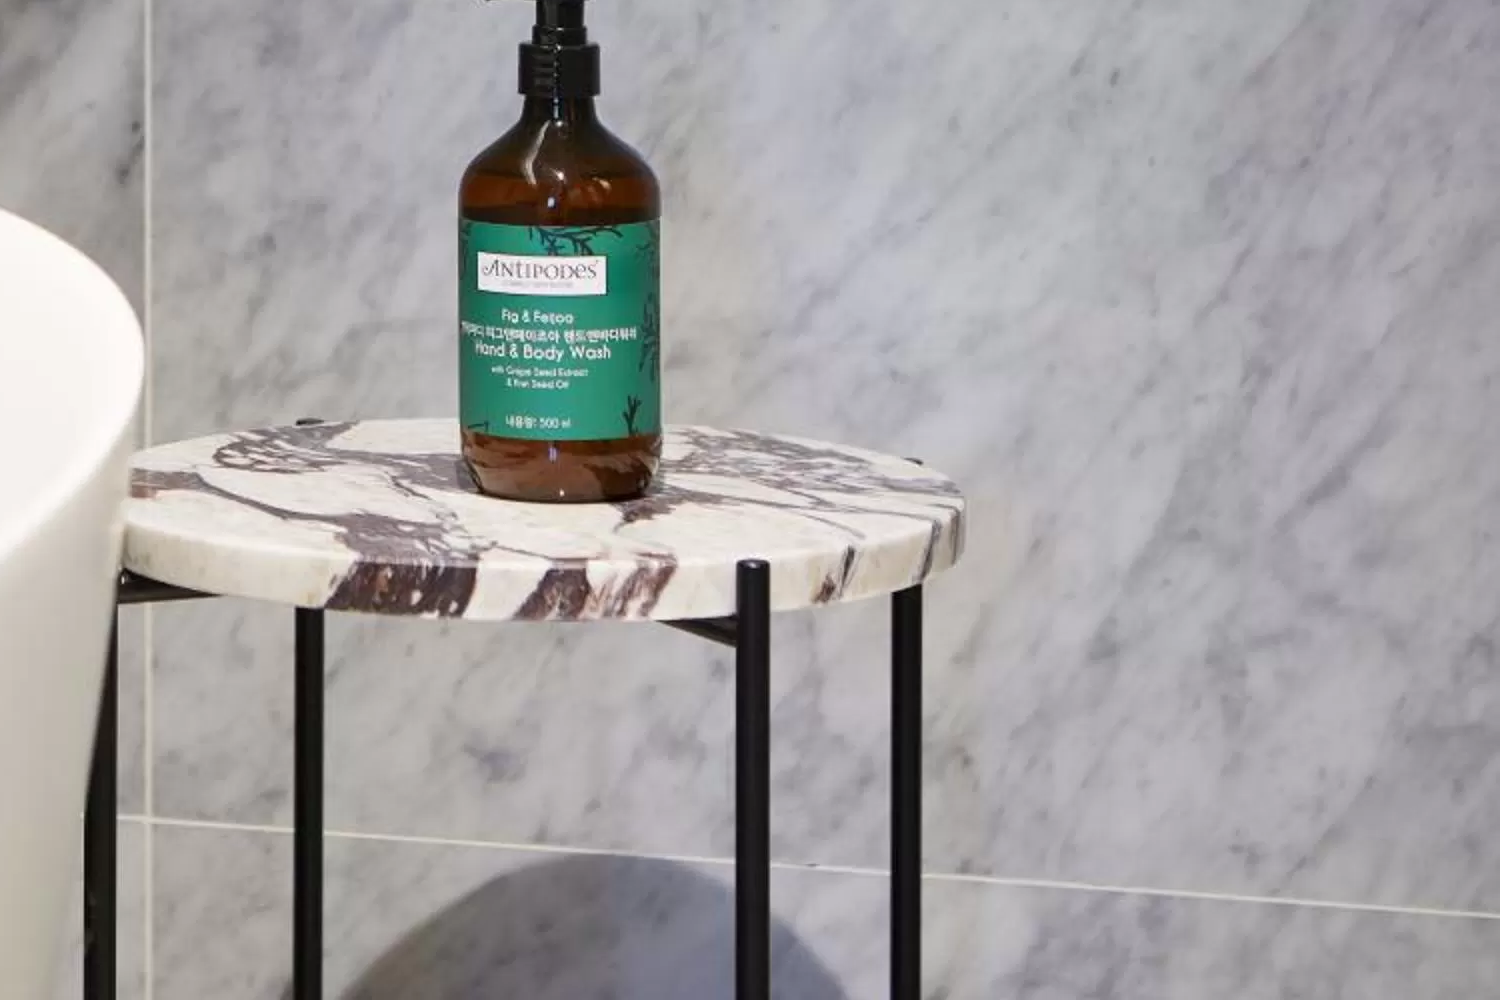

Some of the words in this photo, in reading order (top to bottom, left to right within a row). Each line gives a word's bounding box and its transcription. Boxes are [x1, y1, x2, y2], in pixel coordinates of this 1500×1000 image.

[501, 308, 519, 324] Fig
[521, 310, 531, 323] &
[475, 341, 505, 358] Hand
[509, 343, 519, 358] &
[523, 344, 564, 362] Body
[569, 345, 612, 360] Wash
